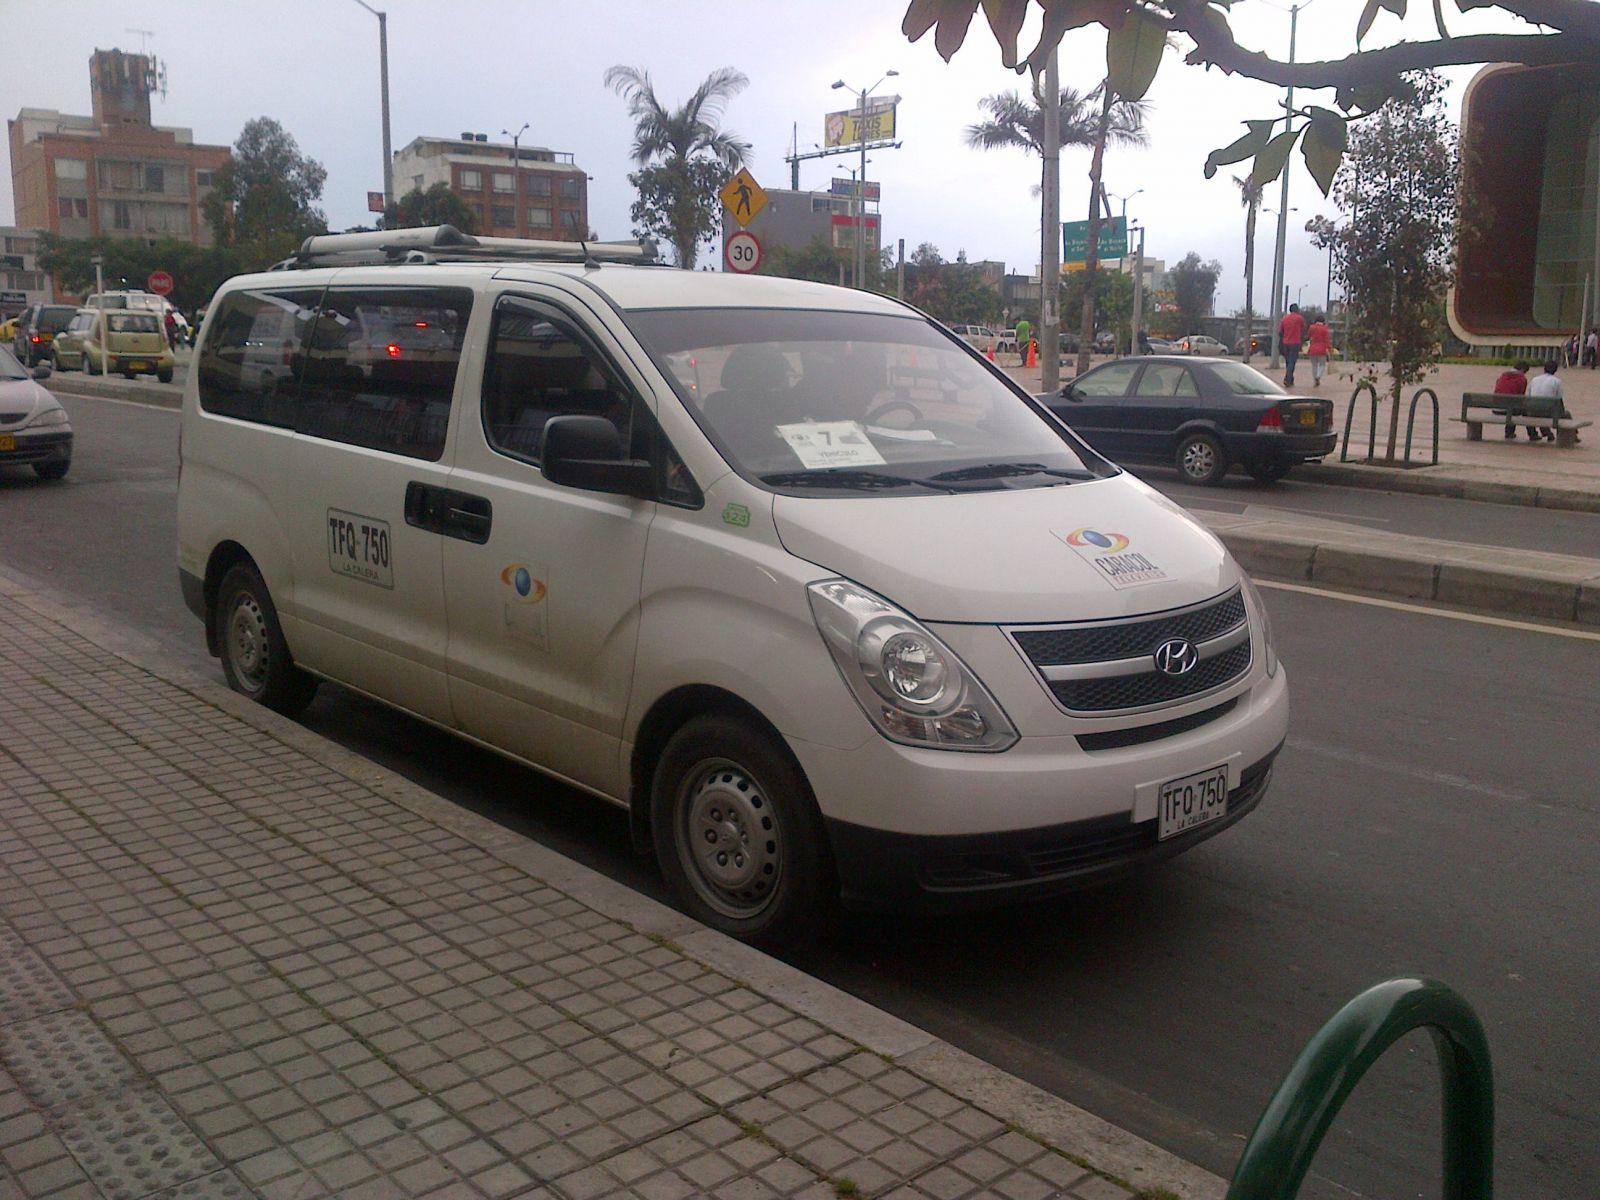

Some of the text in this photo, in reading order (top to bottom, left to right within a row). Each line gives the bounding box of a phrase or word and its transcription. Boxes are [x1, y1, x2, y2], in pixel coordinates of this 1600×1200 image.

[733, 245, 754, 262] 30
[817, 431, 832, 447] 7
[329, 517, 389, 568] TFQ 750
[1094, 552, 1160, 577] CARACOL
[1198, 774, 1227, 811] 750
